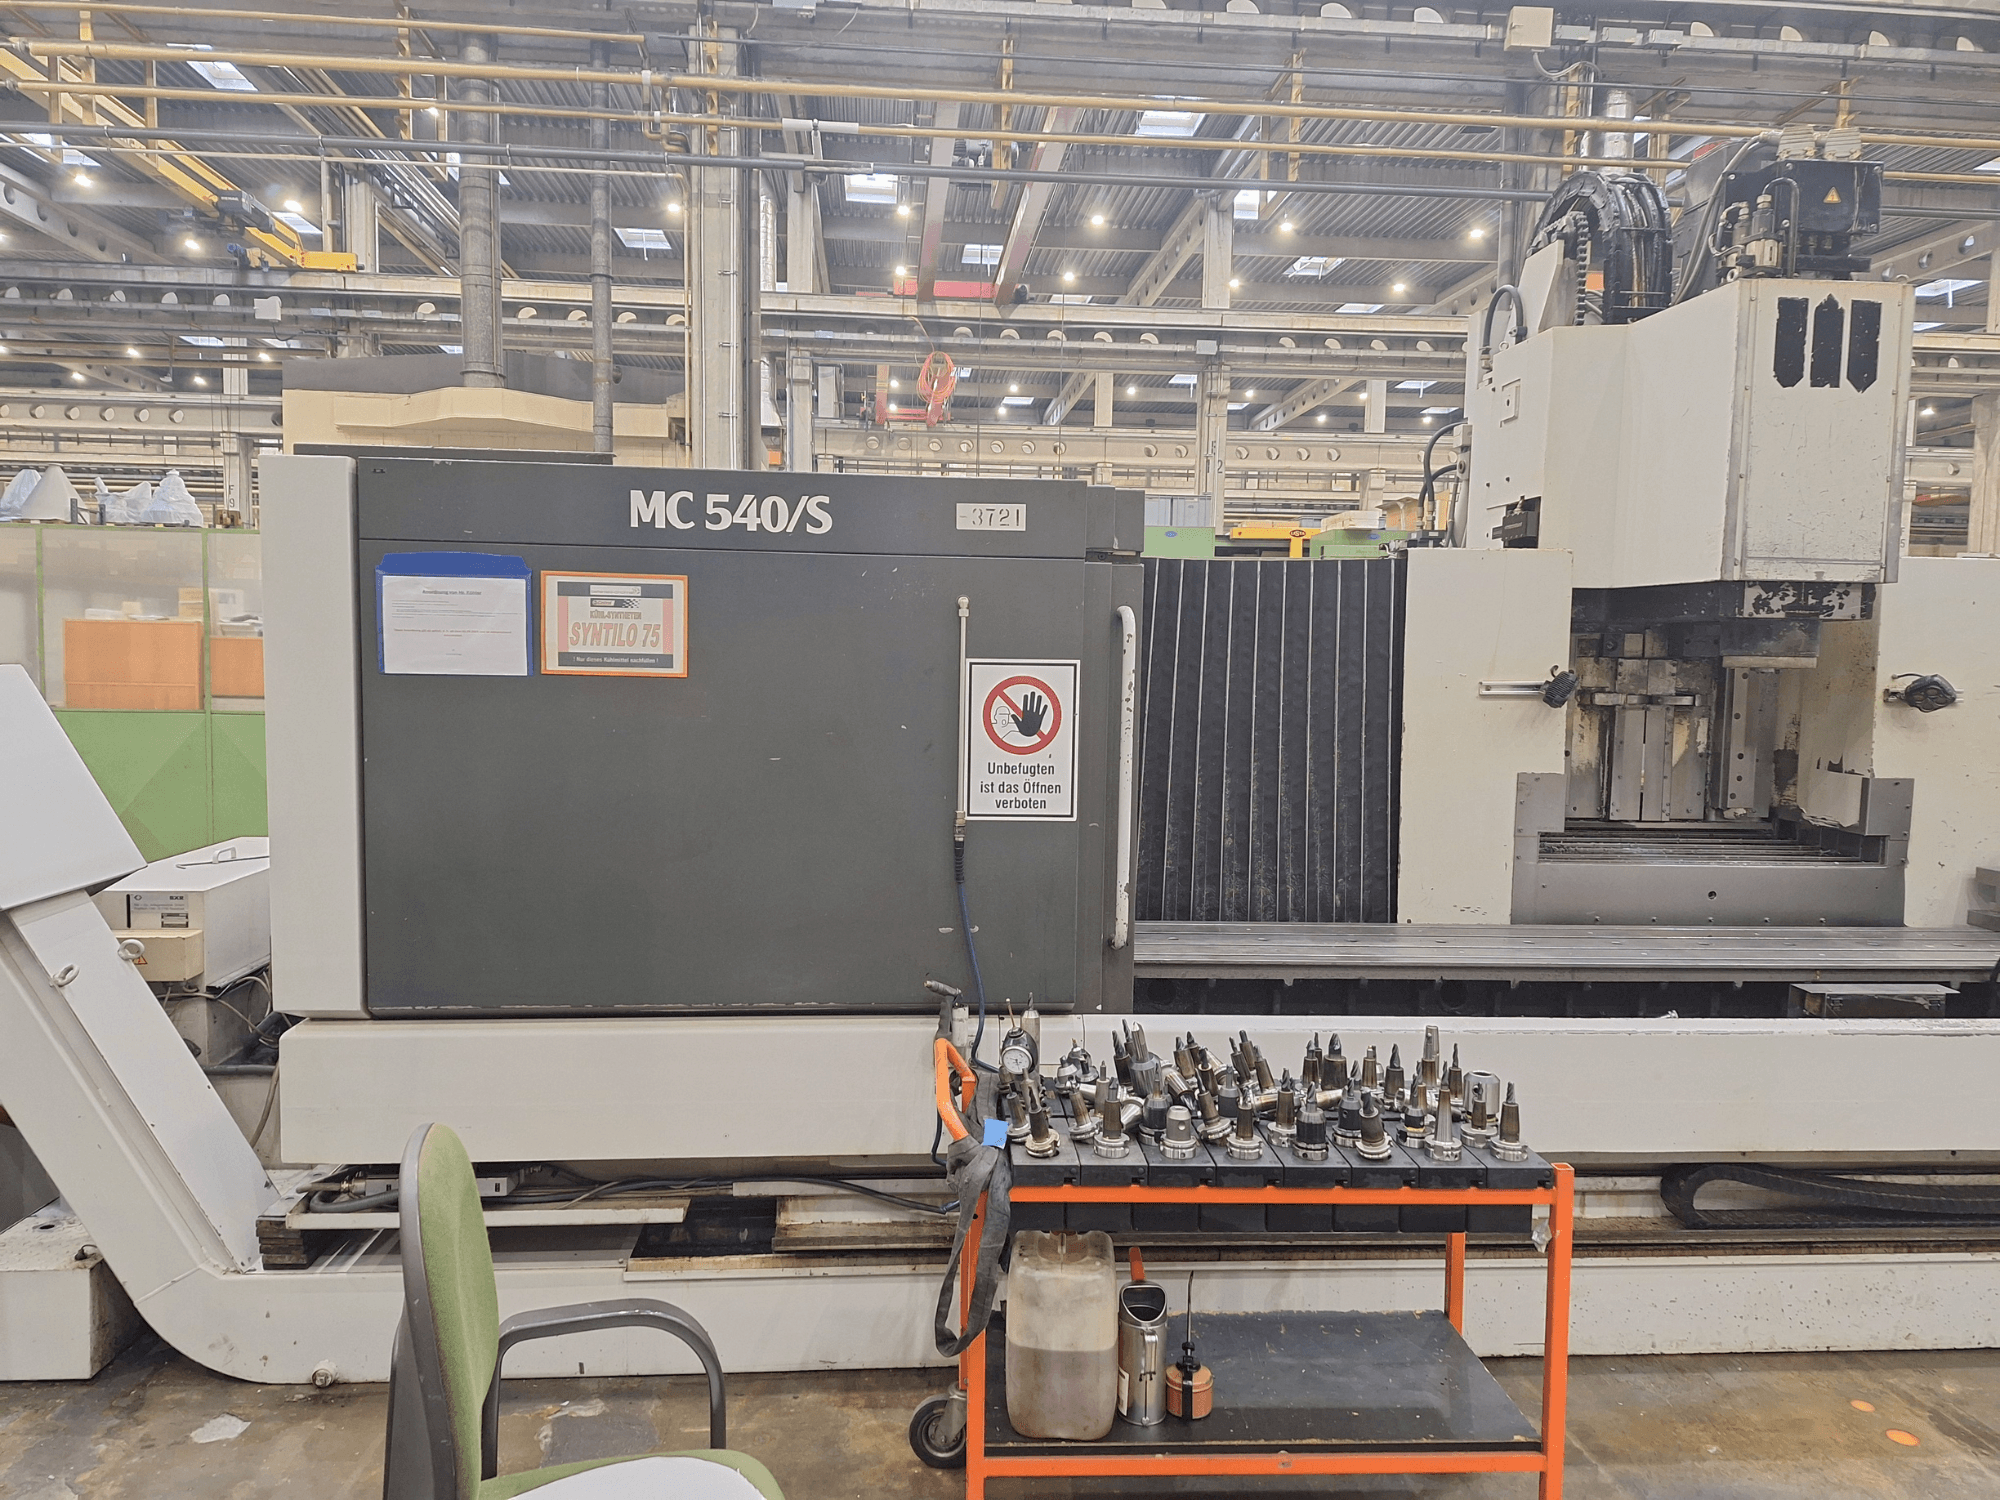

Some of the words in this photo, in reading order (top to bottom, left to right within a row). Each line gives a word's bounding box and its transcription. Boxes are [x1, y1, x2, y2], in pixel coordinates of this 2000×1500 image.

[630, 489, 695, 529] MC
[704, 493, 833, 534] 540/S
[569, 622, 638, 647] SYNTILO
[642, 623, 661, 647] 75
[987, 761, 1055, 777] Unbefugten
[980, 781, 994, 793] ist
[998, 781, 1019, 793] das
[1023, 778, 1061, 794] Öffnen
[995, 797, 1047, 809] verboten
